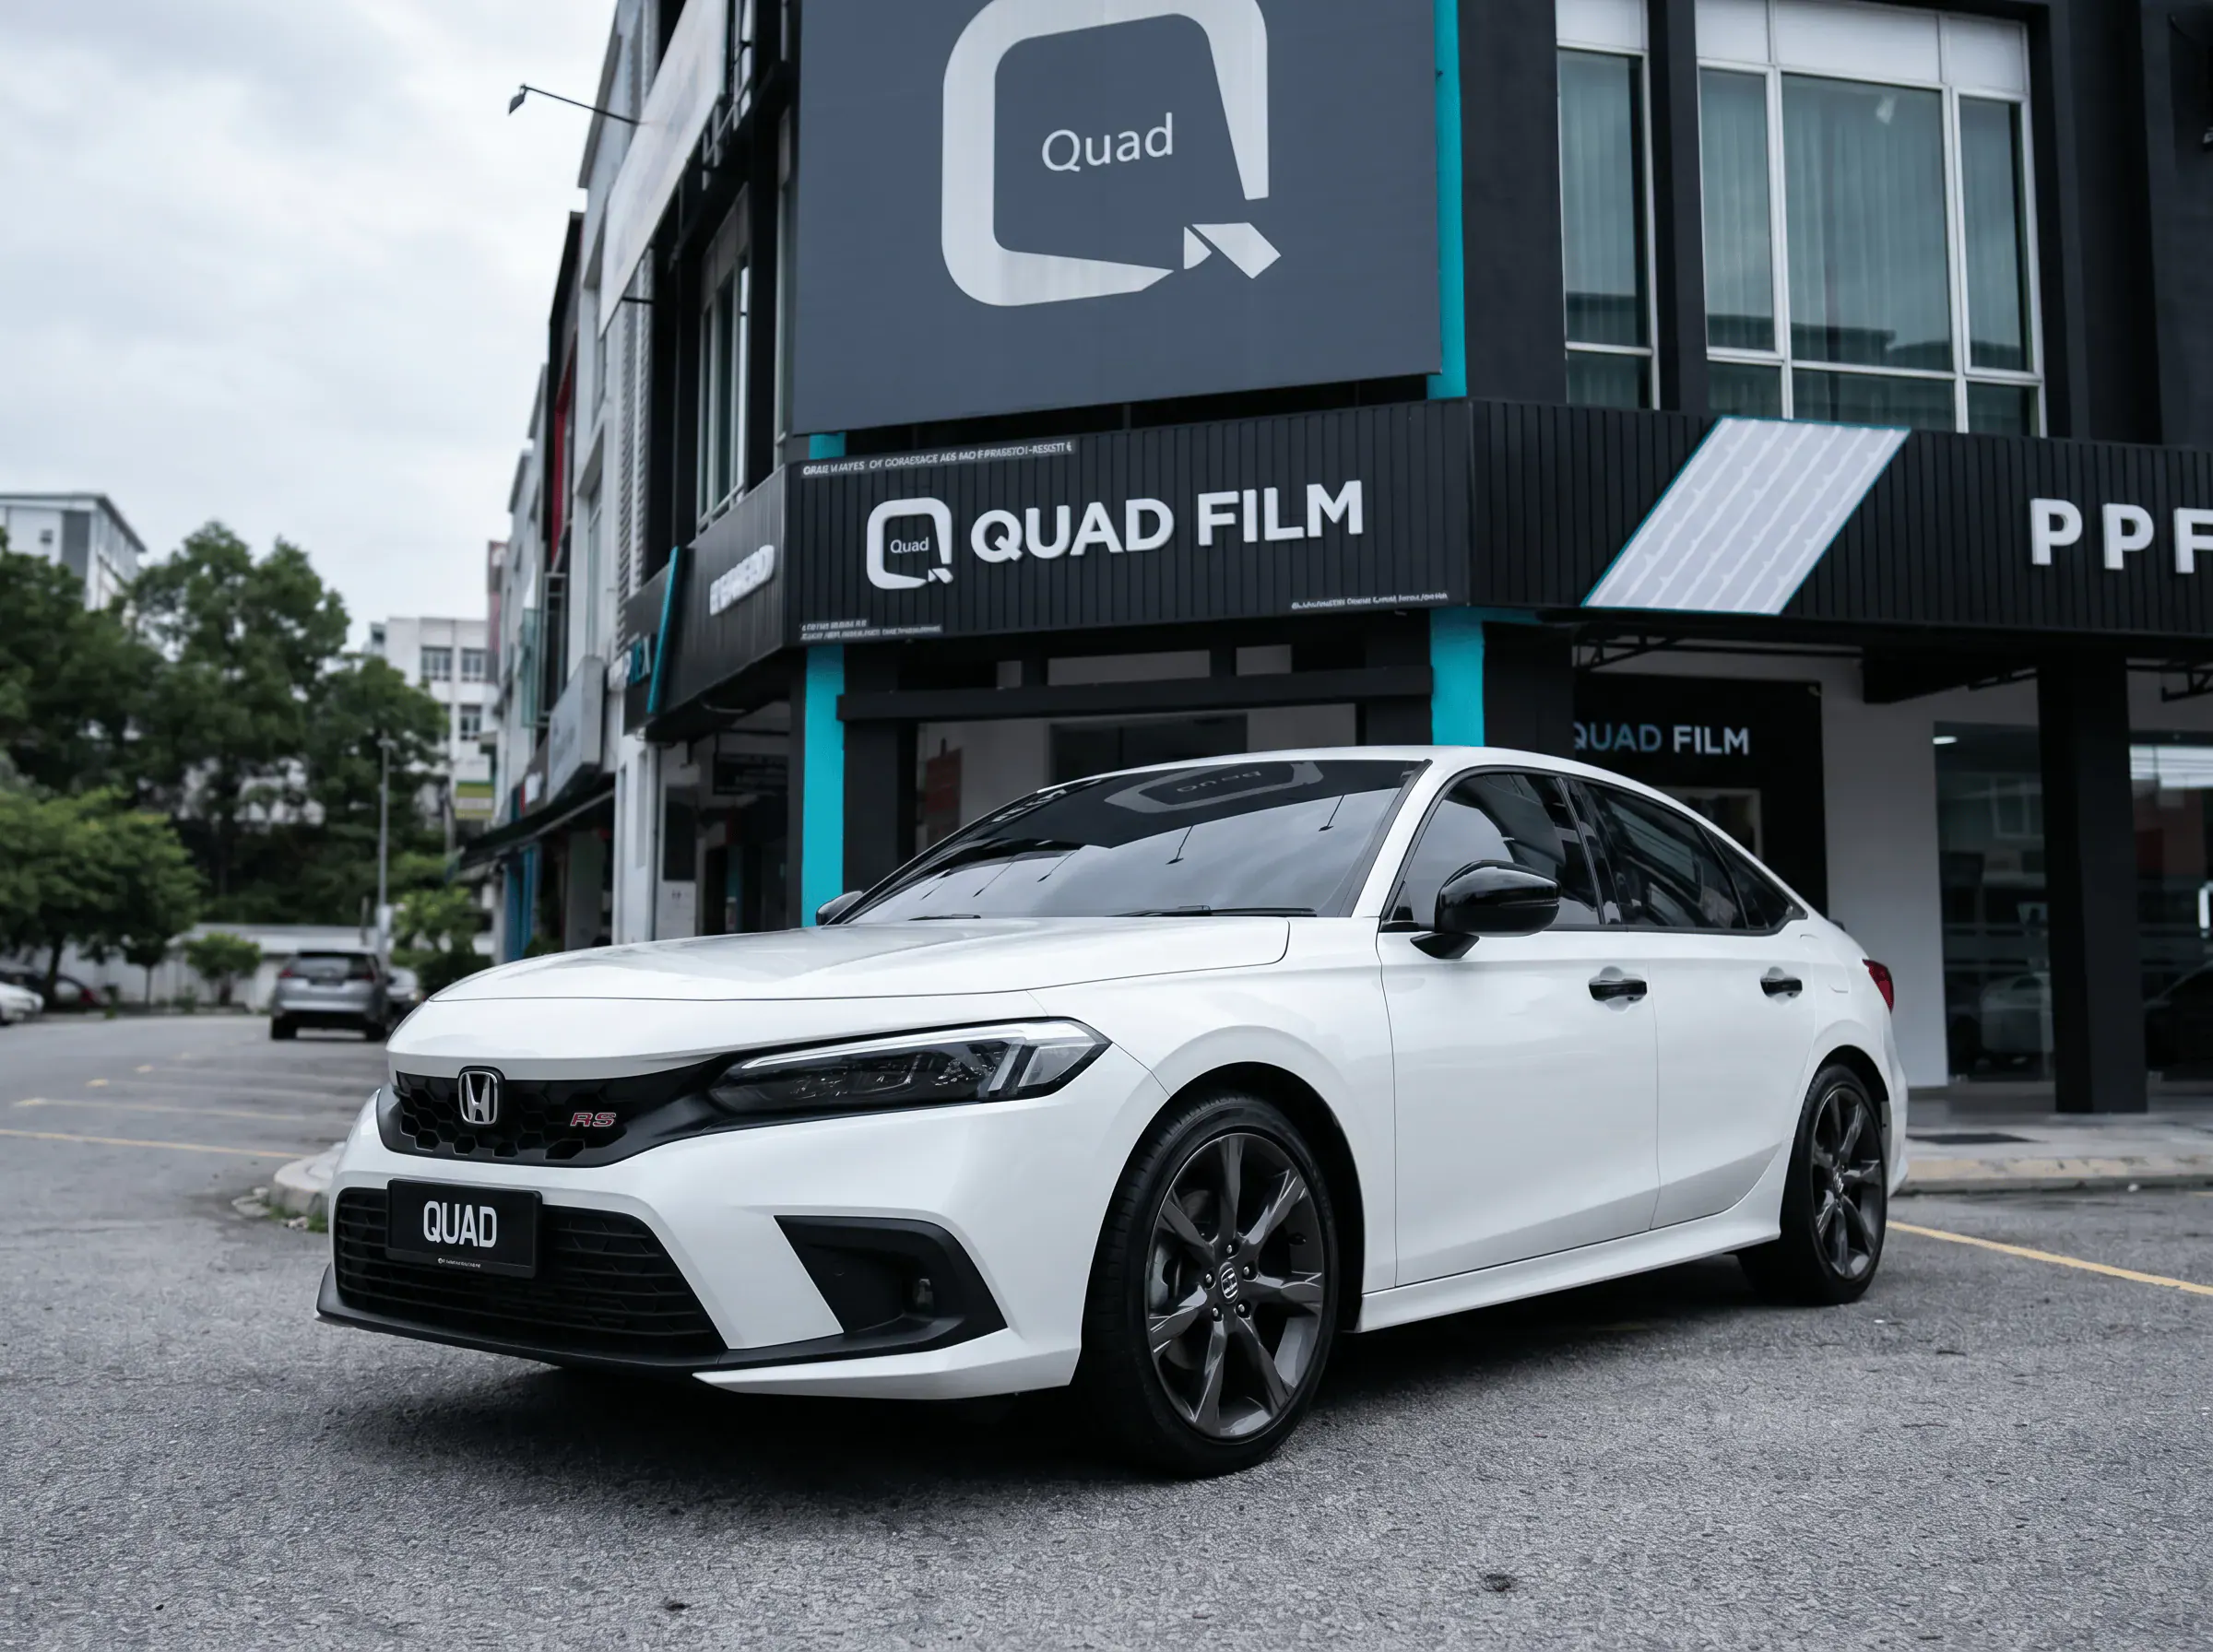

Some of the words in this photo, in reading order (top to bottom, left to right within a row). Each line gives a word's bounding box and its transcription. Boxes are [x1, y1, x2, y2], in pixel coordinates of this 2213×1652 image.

[1041, 112, 1174, 172] Quad
[970, 498, 1175, 564] QUAD
[1198, 479, 1365, 547] FILM
[889, 537, 929, 554] Quad
[1673, 725, 1750, 756] FILM
[569, 1112, 617, 1127] RS
[423, 1200, 498, 1248] QUAD
